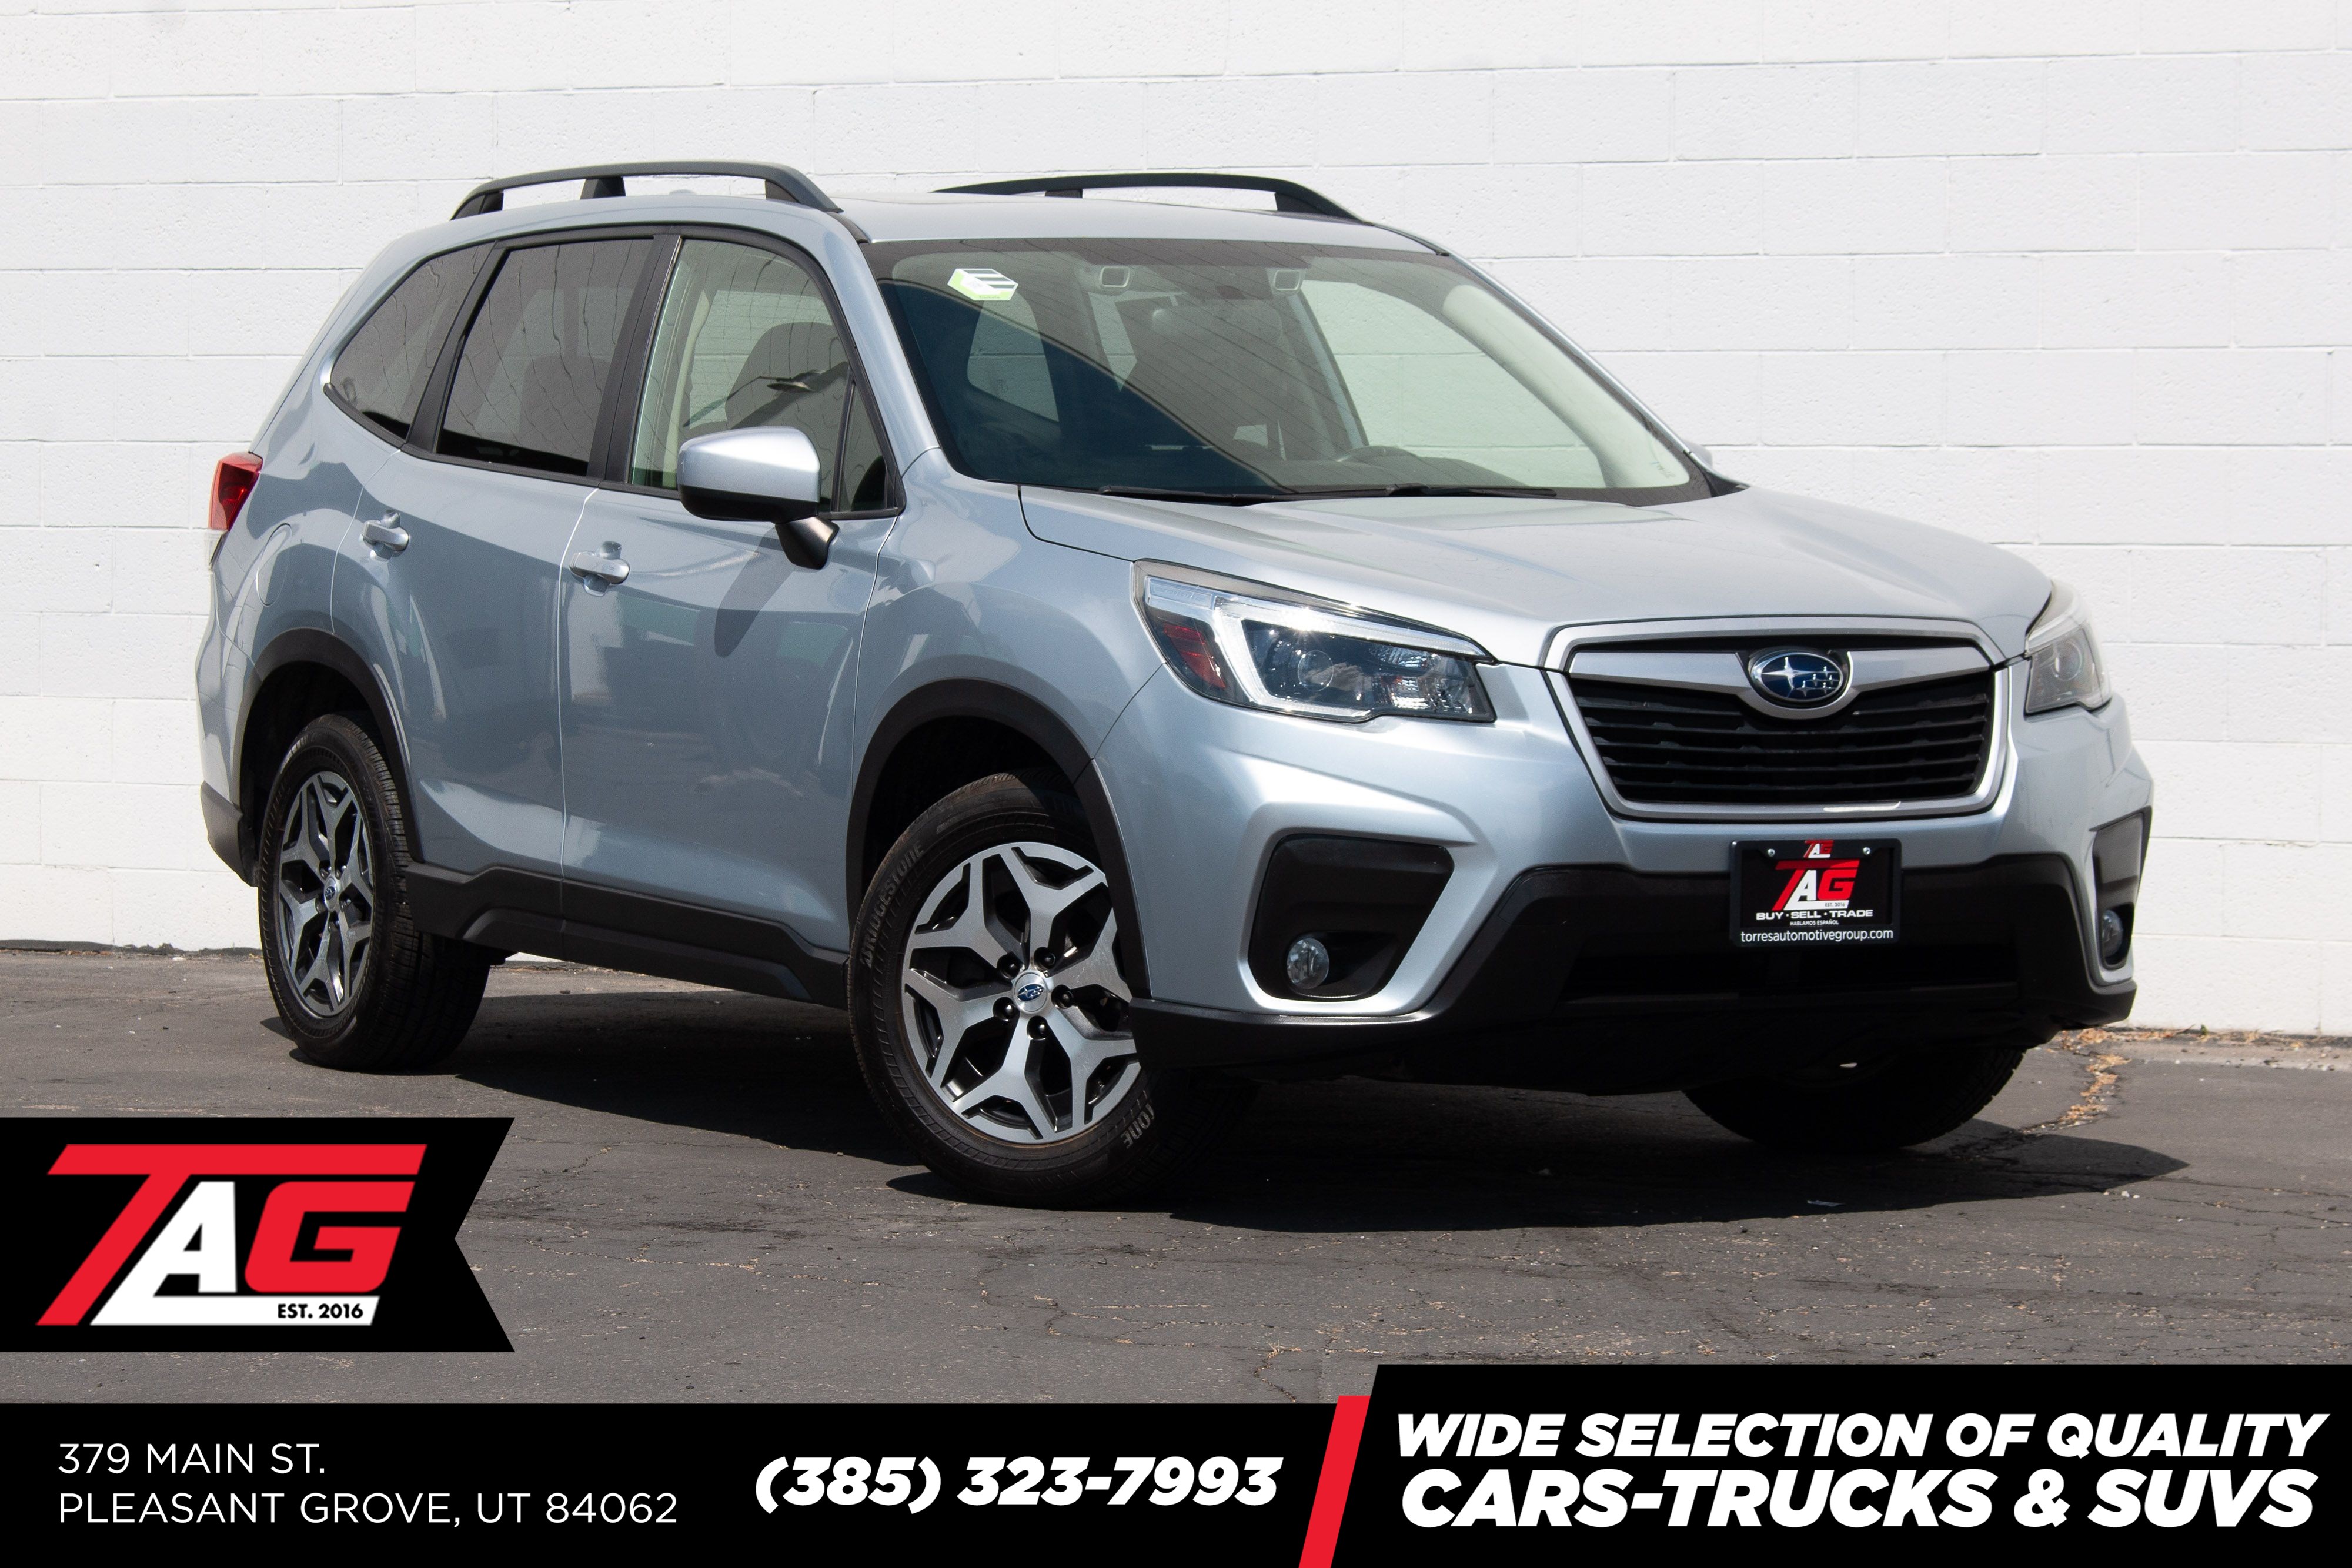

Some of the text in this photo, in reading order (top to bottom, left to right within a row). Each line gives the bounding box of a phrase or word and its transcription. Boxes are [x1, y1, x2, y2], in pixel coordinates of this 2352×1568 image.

[1804, 840, 1834, 858] TAG
[1772, 860, 1860, 911] TAG
[1741, 929, 1893, 942] torresautomotivegroup.com
